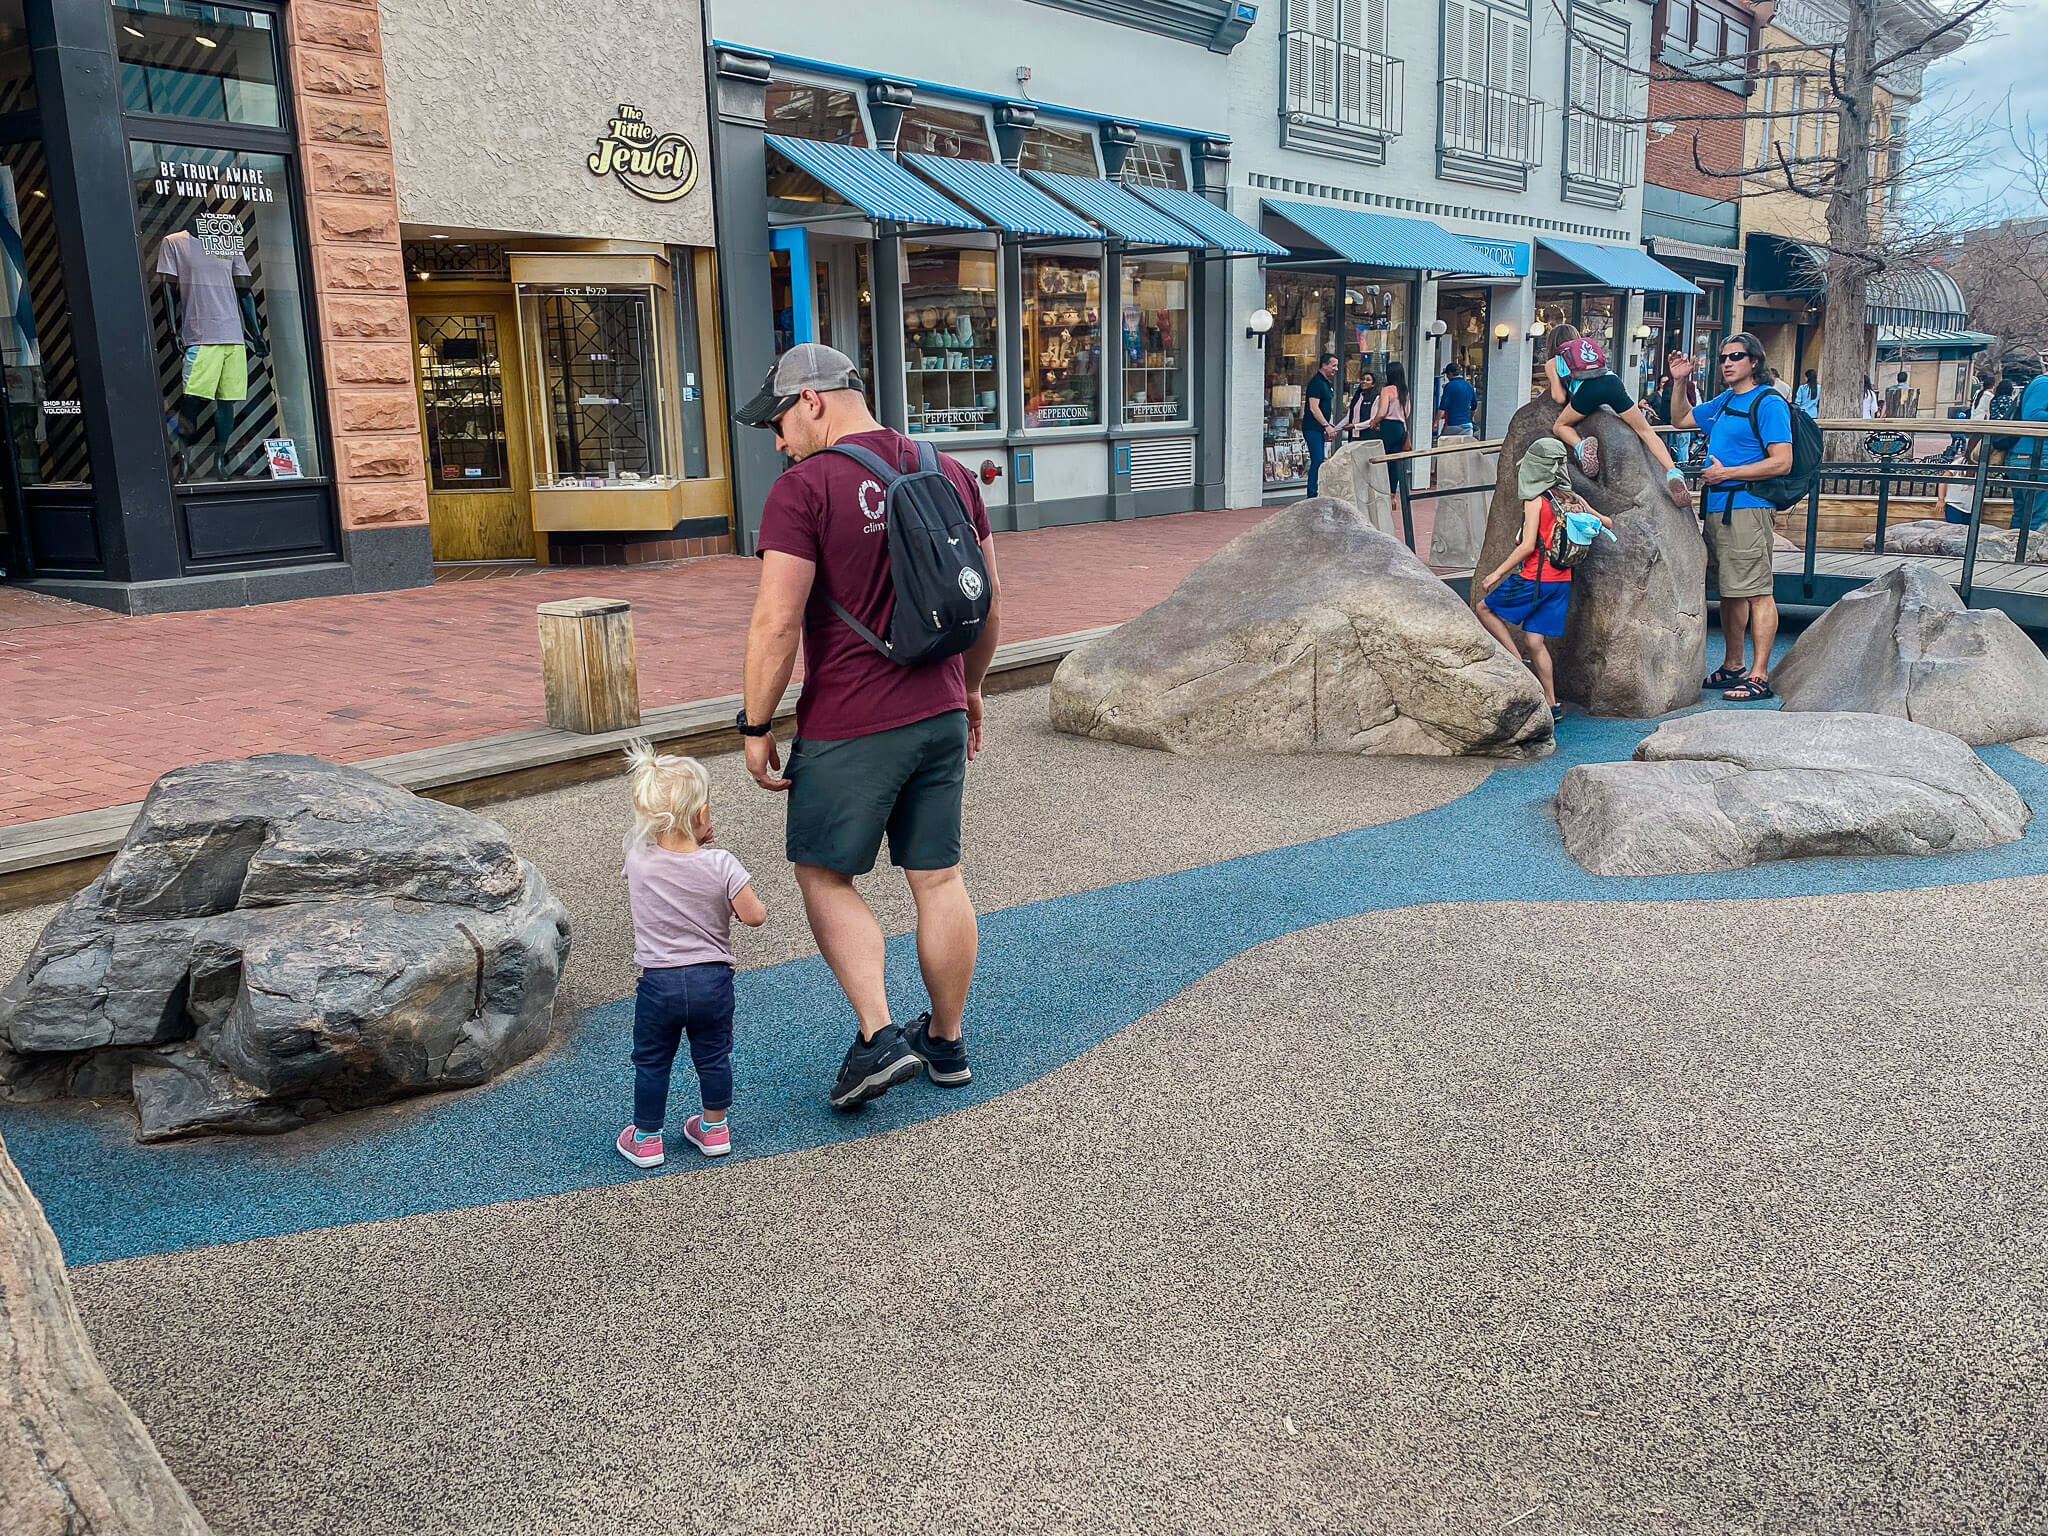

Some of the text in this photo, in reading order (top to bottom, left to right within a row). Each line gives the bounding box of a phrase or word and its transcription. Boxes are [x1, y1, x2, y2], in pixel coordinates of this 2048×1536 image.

[620, 105, 643, 120] The
[609, 119, 655, 144] Little
[589, 137, 692, 188] Jewel
[160, 161, 264, 185] BE TRULY AWARE
[155, 179, 274, 203] OF WHAT YOU WEAR
[200, 212, 236, 220] VOLCOM
[195, 218, 234, 235] ECO
[198, 234, 246, 252] TRUE
[925, 411, 984, 423] PEPPERCORN
[1037, 407, 1088, 419] PEPPERCORN
[1133, 404, 1178, 415] PEPPERCORN
[863, 522, 887, 534] clim
